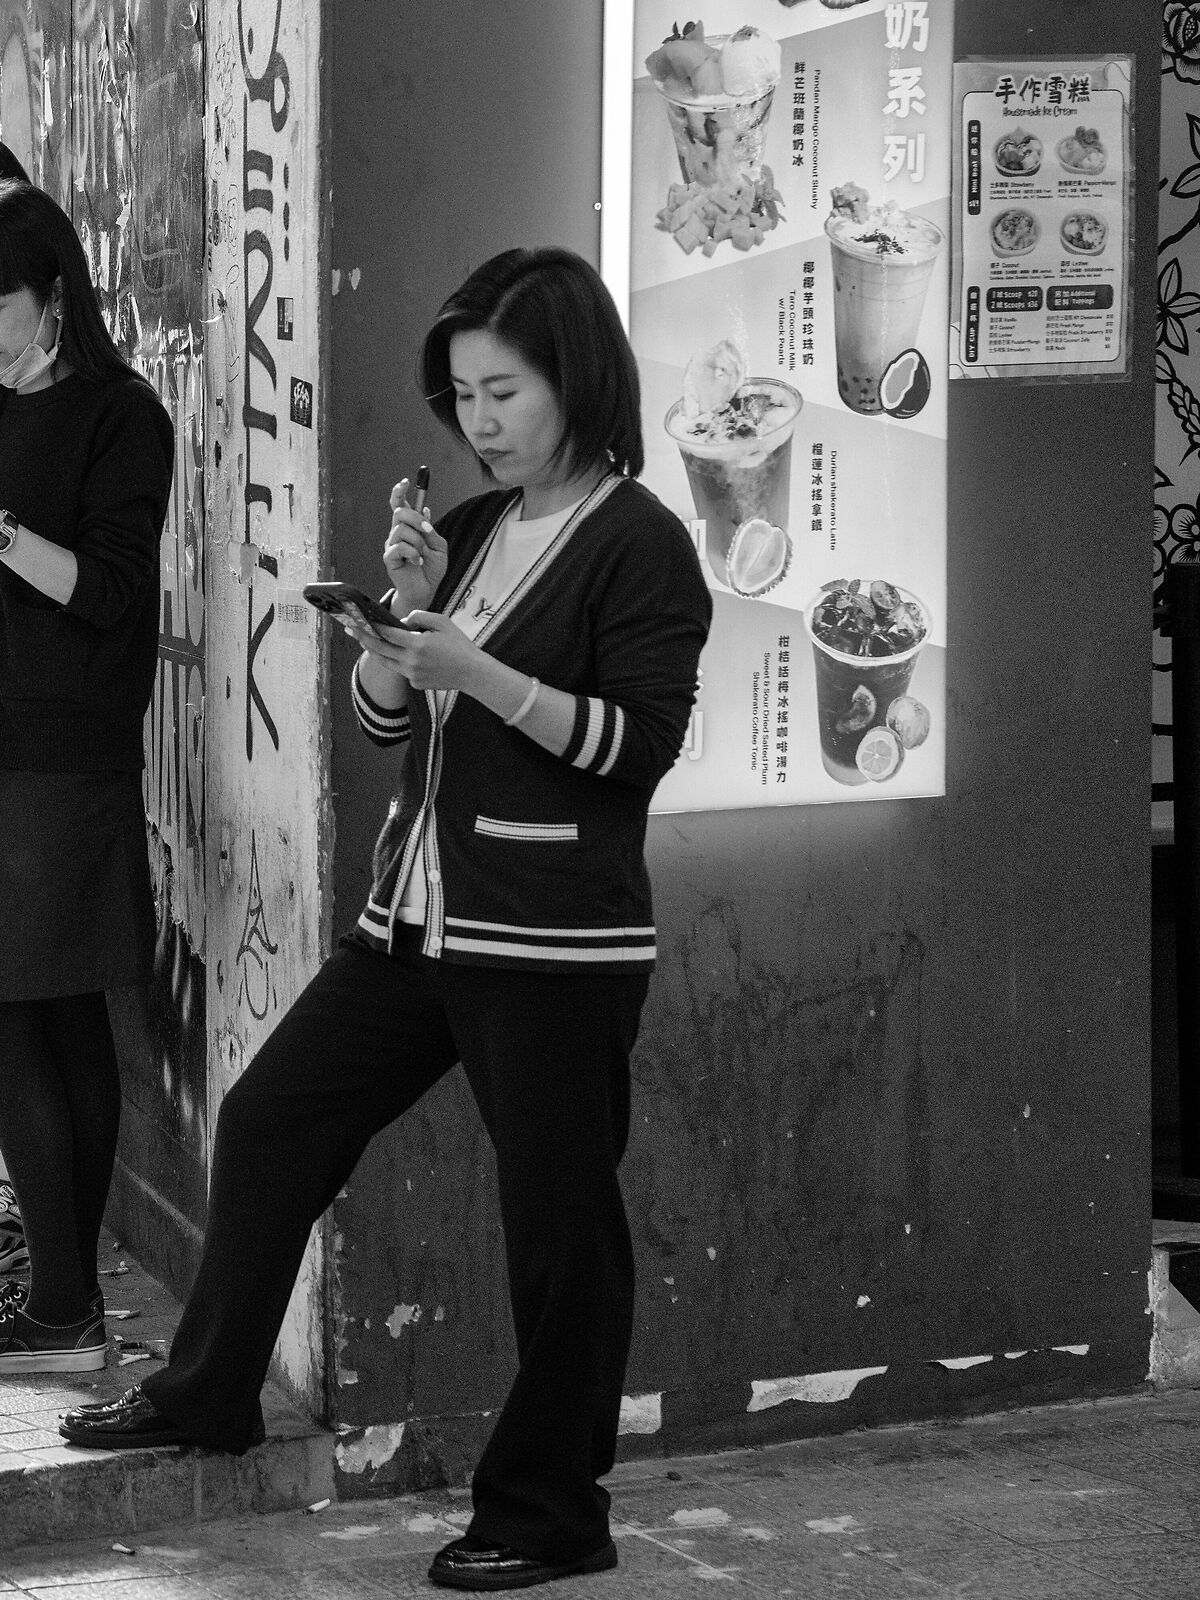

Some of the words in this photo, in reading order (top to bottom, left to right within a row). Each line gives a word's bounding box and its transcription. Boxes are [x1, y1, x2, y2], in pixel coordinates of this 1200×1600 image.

[812, 69, 821, 104] Pandan
[881, 1, 930, 183] 奶系列
[995, 76, 1090, 105] 手作雪糕
[812, 105, 820, 138] Mango
[1053, 105, 1078, 118] Cream
[811, 138, 820, 178] Coconut
[810, 179, 819, 210] Slushy
[778, 297, 785, 310] w/
[788, 289, 796, 311] Taro
[788, 311, 796, 350] Coconut
[788, 352, 796, 372] Milk
[968, 345, 976, 358] DIY
[829, 527, 837, 551] Latte
[762, 652, 770, 679] Sweet
[751, 716, 759, 745] Coffee
[762, 709, 770, 733] Dried
[750, 746, 758, 771] Tonic
[761, 734, 769, 762] Salted
[761, 762, 769, 785] Plum
